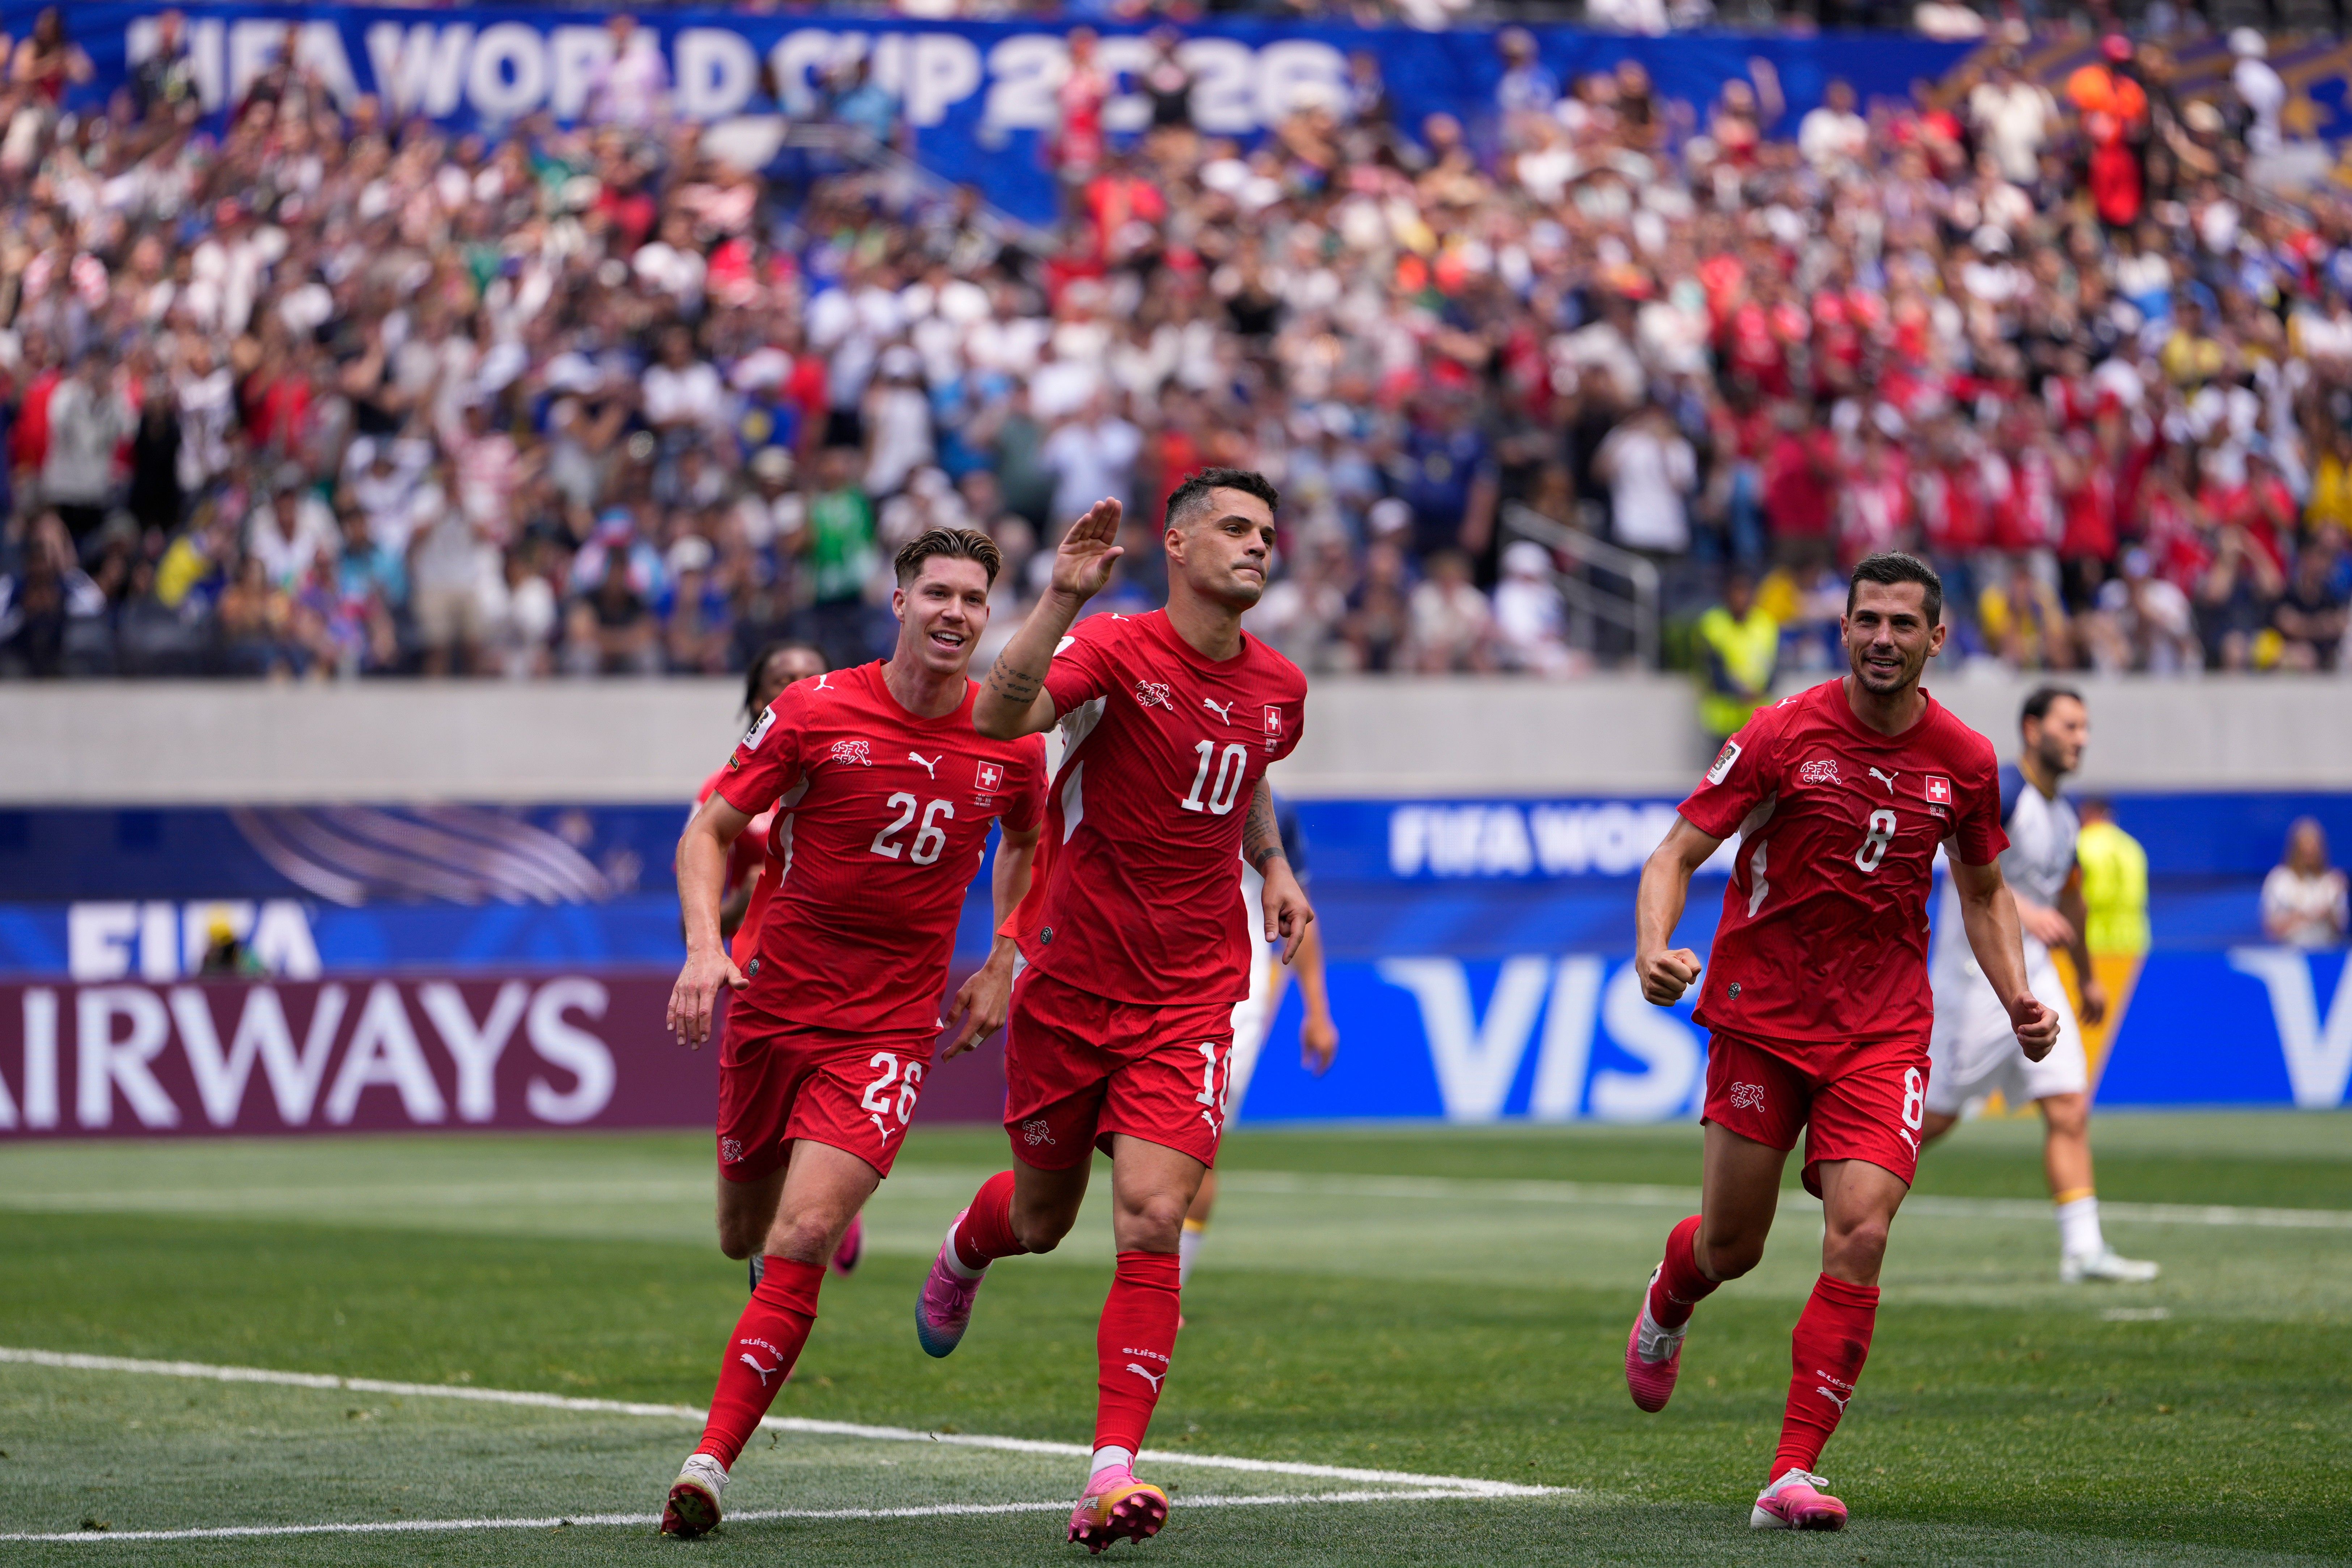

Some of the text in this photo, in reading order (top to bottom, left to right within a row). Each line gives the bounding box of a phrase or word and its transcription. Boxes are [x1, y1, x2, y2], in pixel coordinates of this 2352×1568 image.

[1181, 739, 1247, 815] 10
[870, 792, 955, 865] 26
[1855, 809, 1897, 872] 8
[1379, 955, 1708, 1120] VIS
[861, 1052, 923, 1125] 26
[1902, 1066, 1924, 1131] 8
[739, 1338, 784, 1361] suisse
